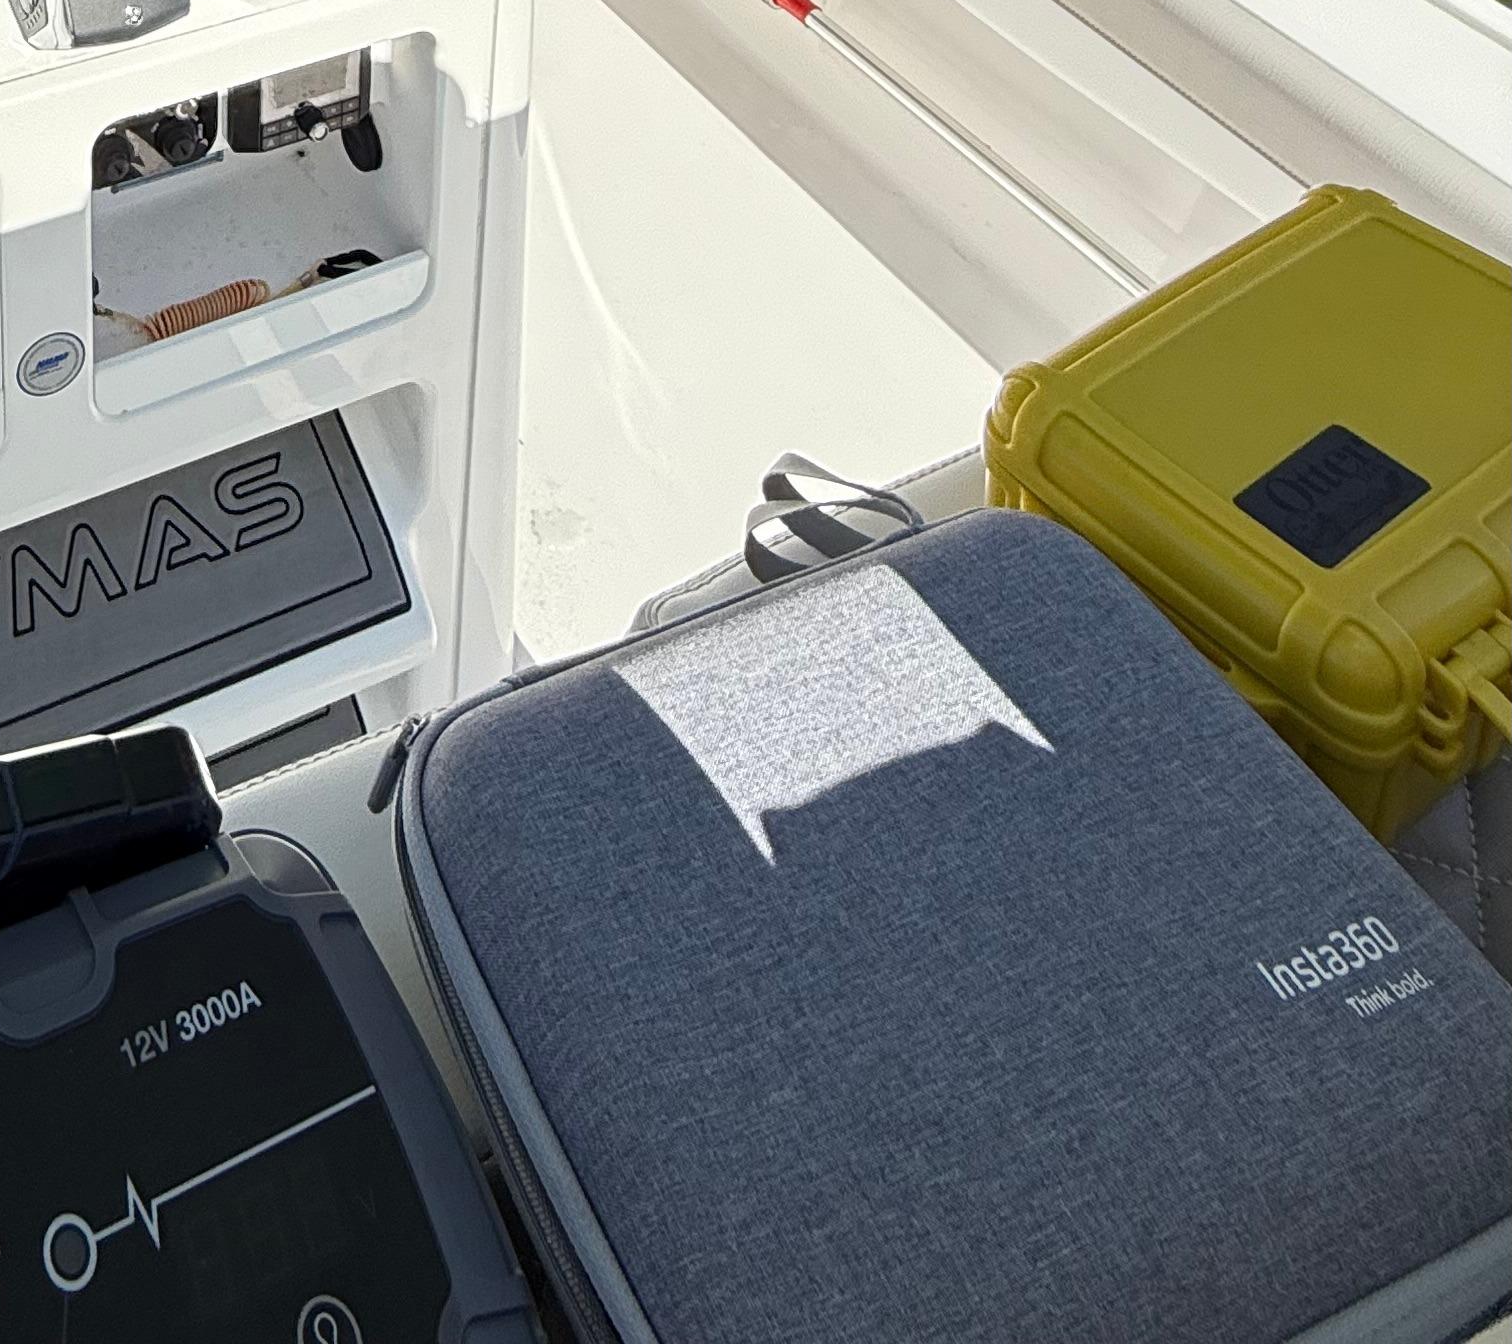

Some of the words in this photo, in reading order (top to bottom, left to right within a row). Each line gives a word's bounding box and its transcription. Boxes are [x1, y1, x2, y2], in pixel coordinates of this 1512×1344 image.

[1257, 915, 1400, 1002] Insta360
[1344, 985, 1396, 1018] Think
[1386, 967, 1435, 1000] bold.
[120, 1019, 170, 1068] 12V
[176, 980, 263, 1042] 3000A
